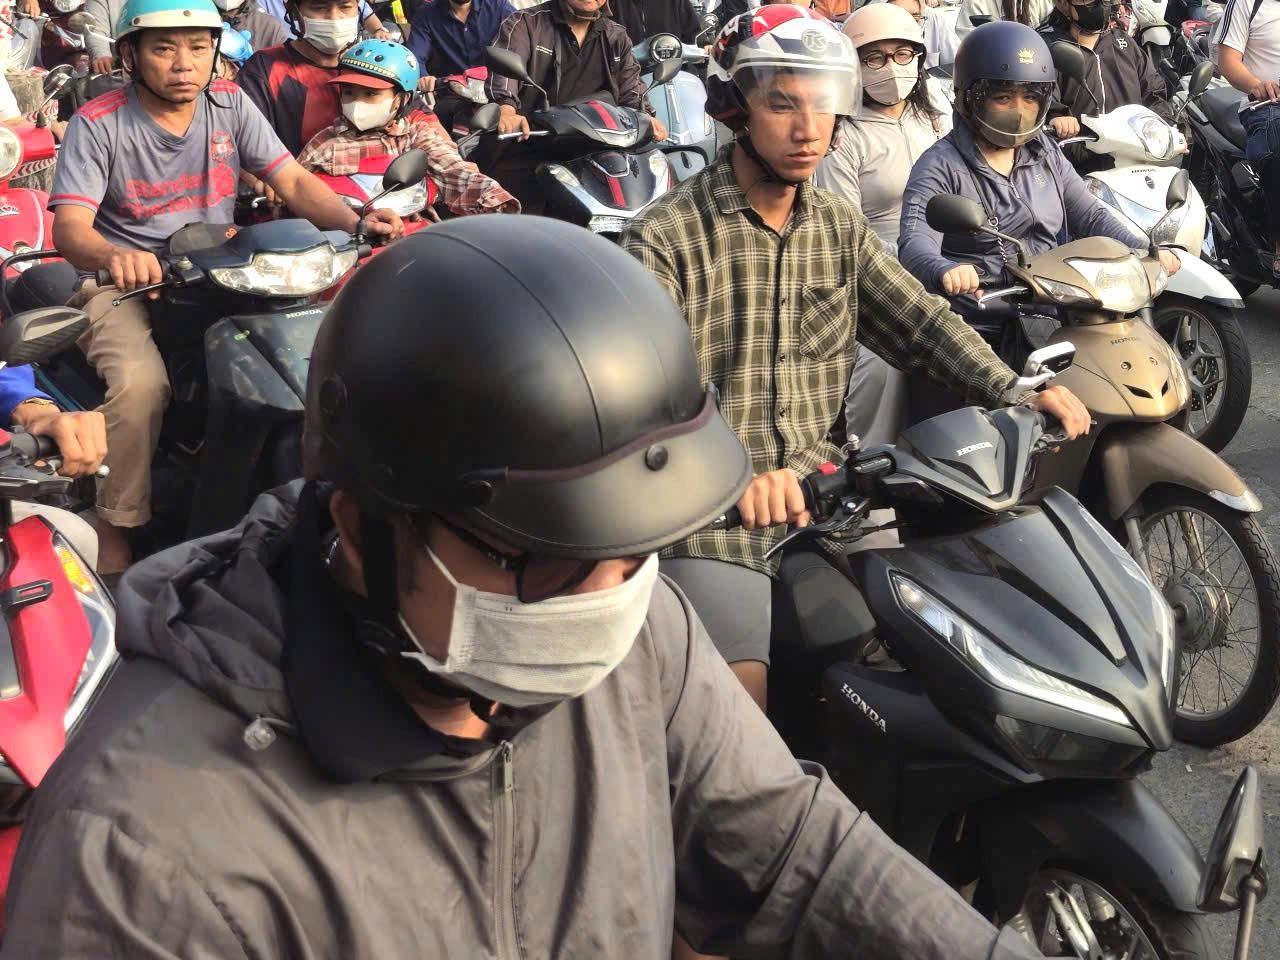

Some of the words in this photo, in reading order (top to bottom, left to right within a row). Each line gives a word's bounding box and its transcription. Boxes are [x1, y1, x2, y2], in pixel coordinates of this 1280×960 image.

[285, 309, 323, 319] HONDA
[956, 441, 993, 457] HONDA
[840, 682, 888, 733] HONDA
